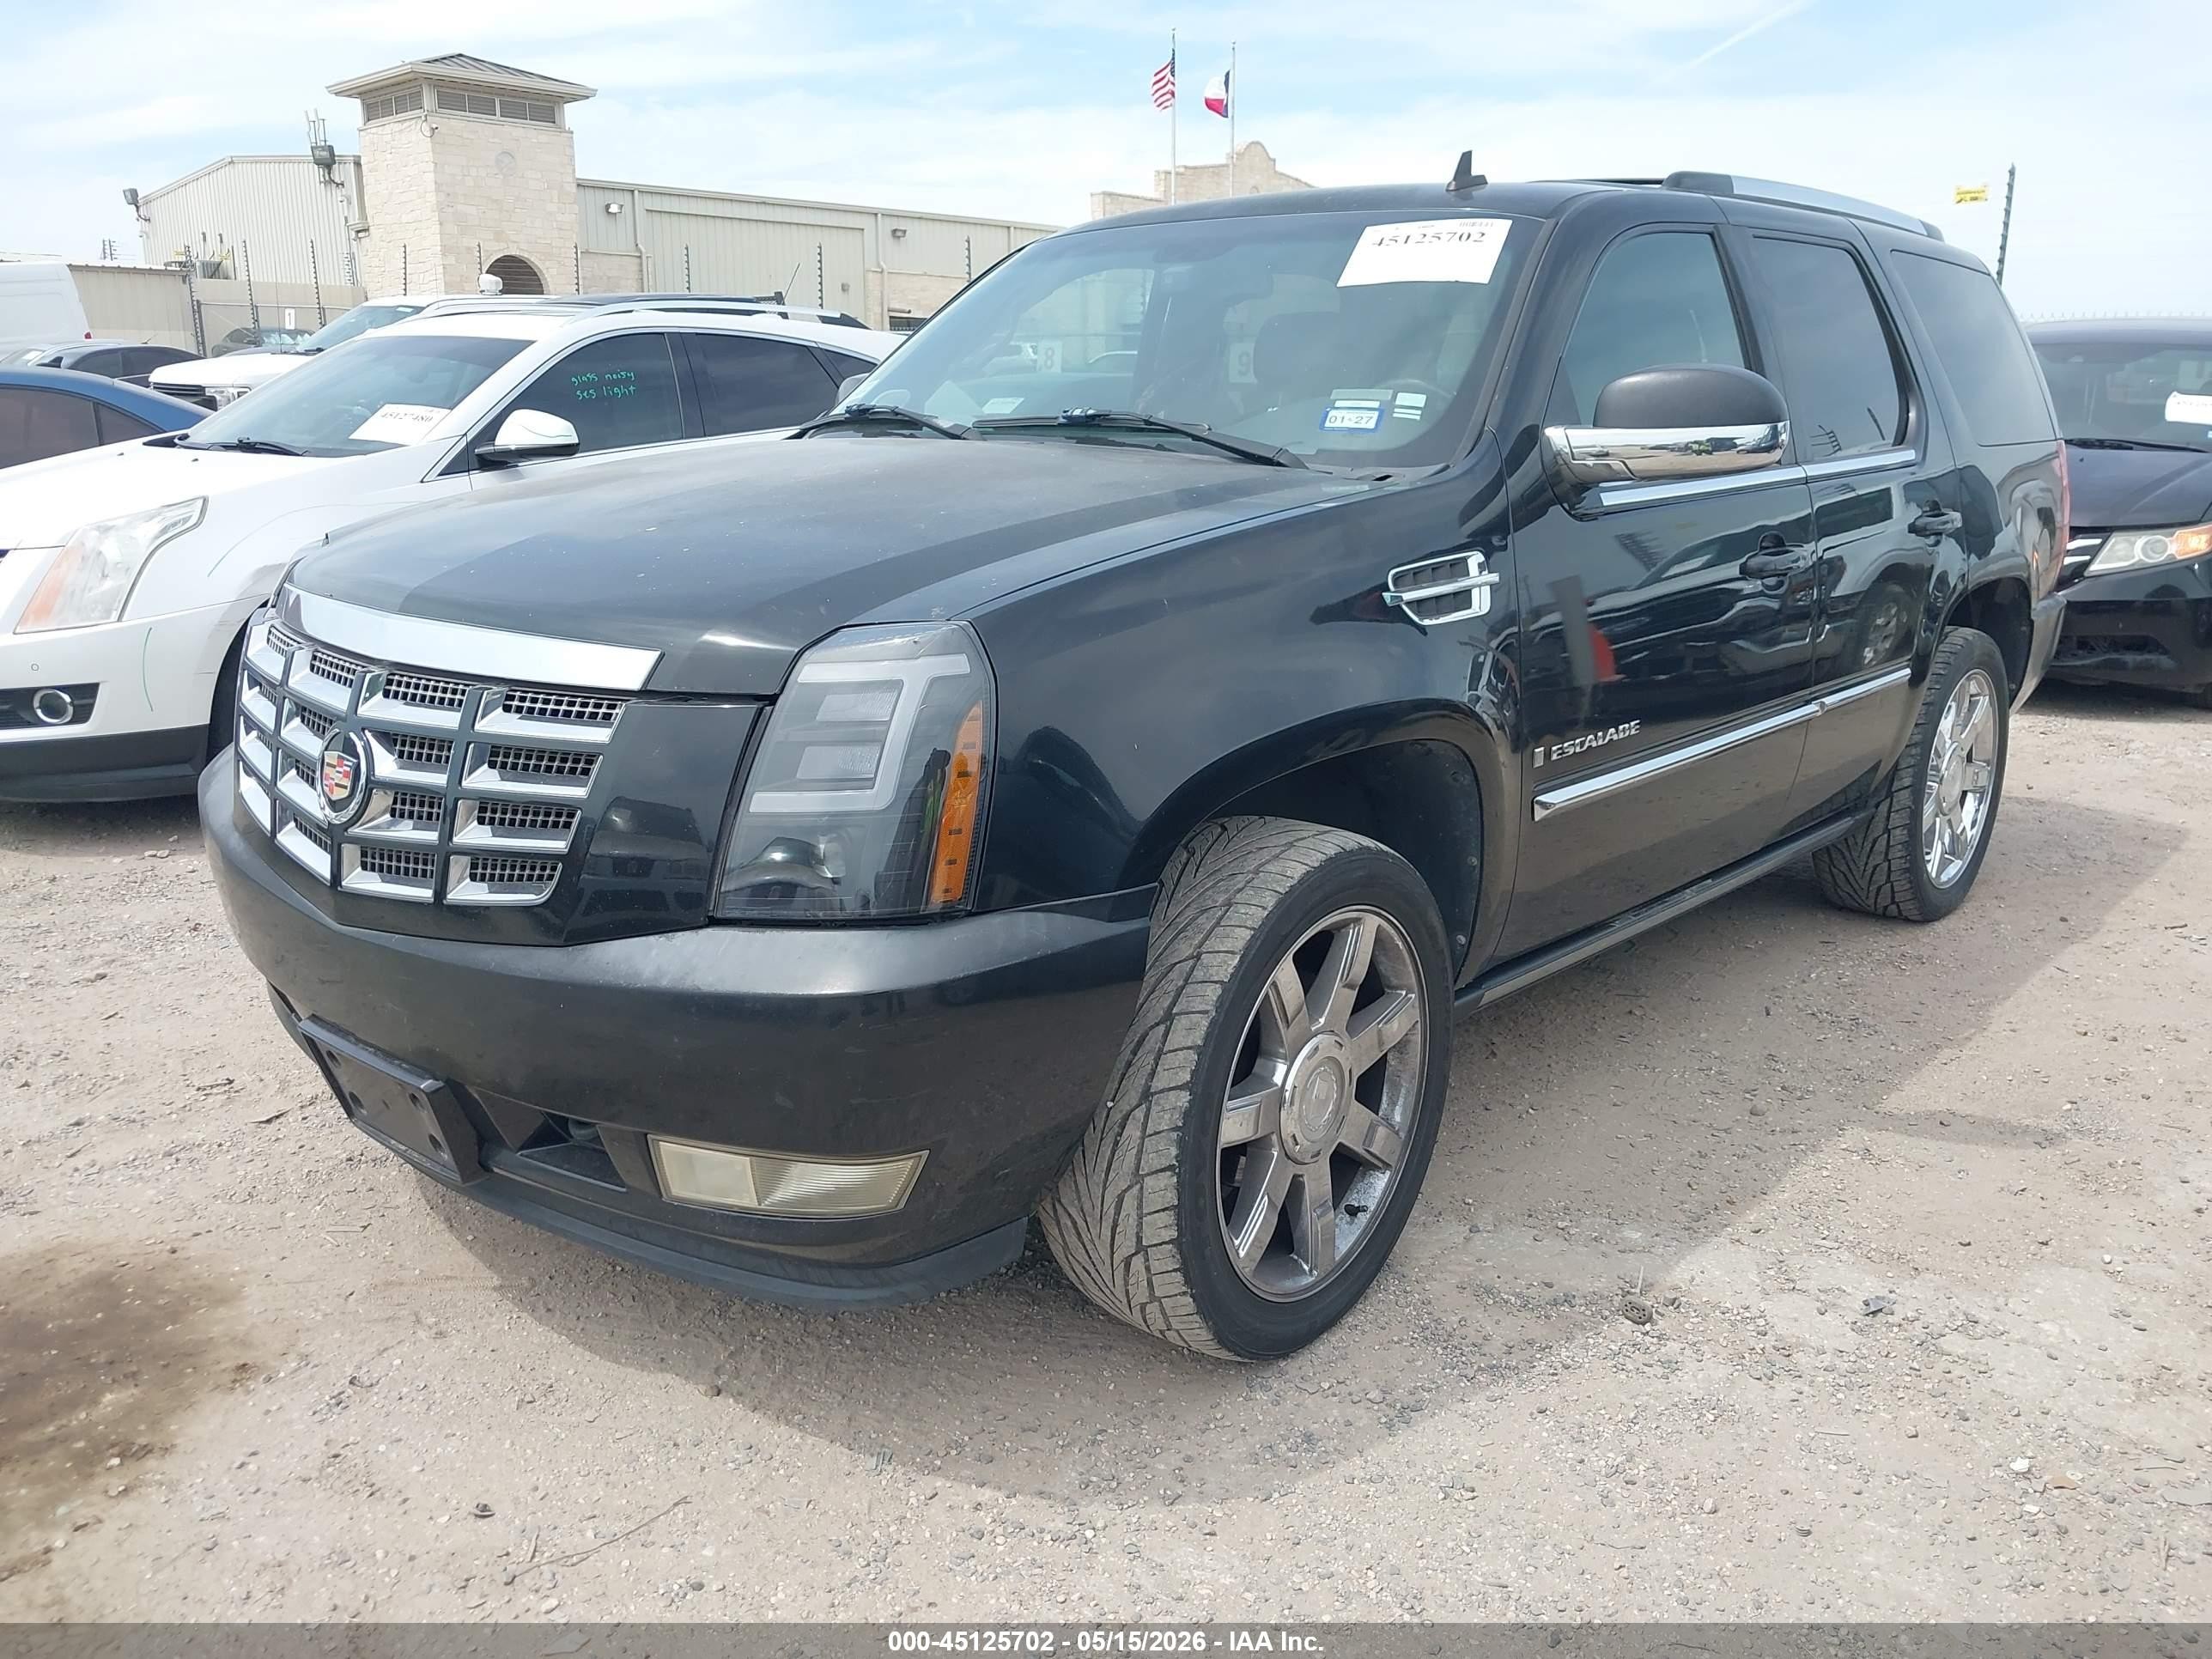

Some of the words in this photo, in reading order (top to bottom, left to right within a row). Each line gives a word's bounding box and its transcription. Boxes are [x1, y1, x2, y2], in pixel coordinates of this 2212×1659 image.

[1372, 231, 1486, 247] 45125702
[1043, 346, 1055, 370] 8
[1237, 350, 1251, 377] 9
[571, 373, 599, 386] glass
[605, 369, 635, 381] noisy
[603, 385, 636, 398] light
[1550, 720, 1641, 762] ESCALADE
